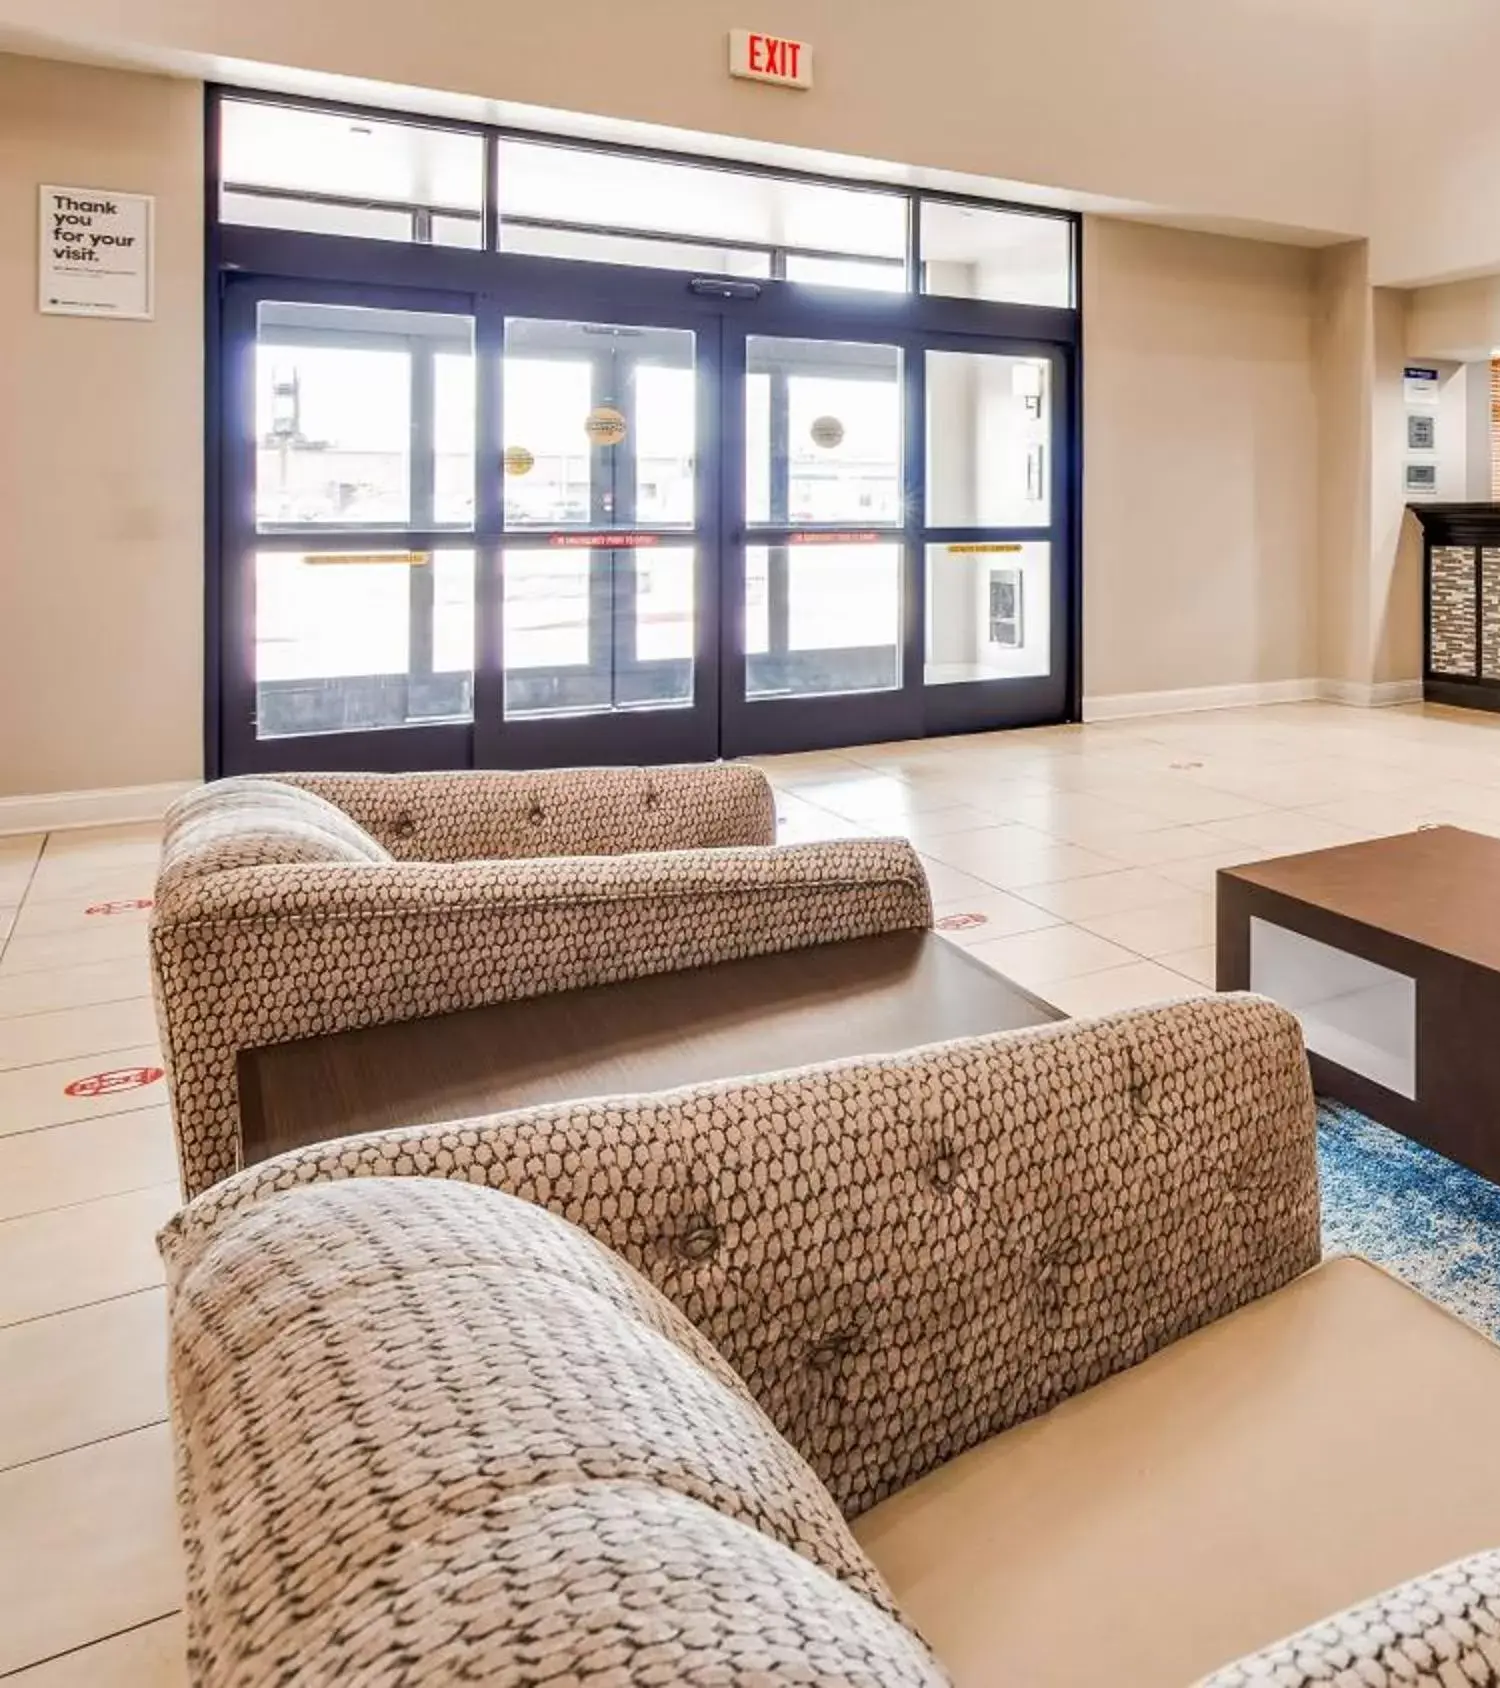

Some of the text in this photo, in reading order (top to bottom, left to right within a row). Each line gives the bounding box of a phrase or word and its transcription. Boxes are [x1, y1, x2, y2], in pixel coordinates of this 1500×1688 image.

[749, 35, 801, 79] EXIT
[53, 195, 117, 214] Thank
[53, 213, 92, 226] you
[53, 227, 136, 247] for your
[53, 246, 99, 261] visit.
